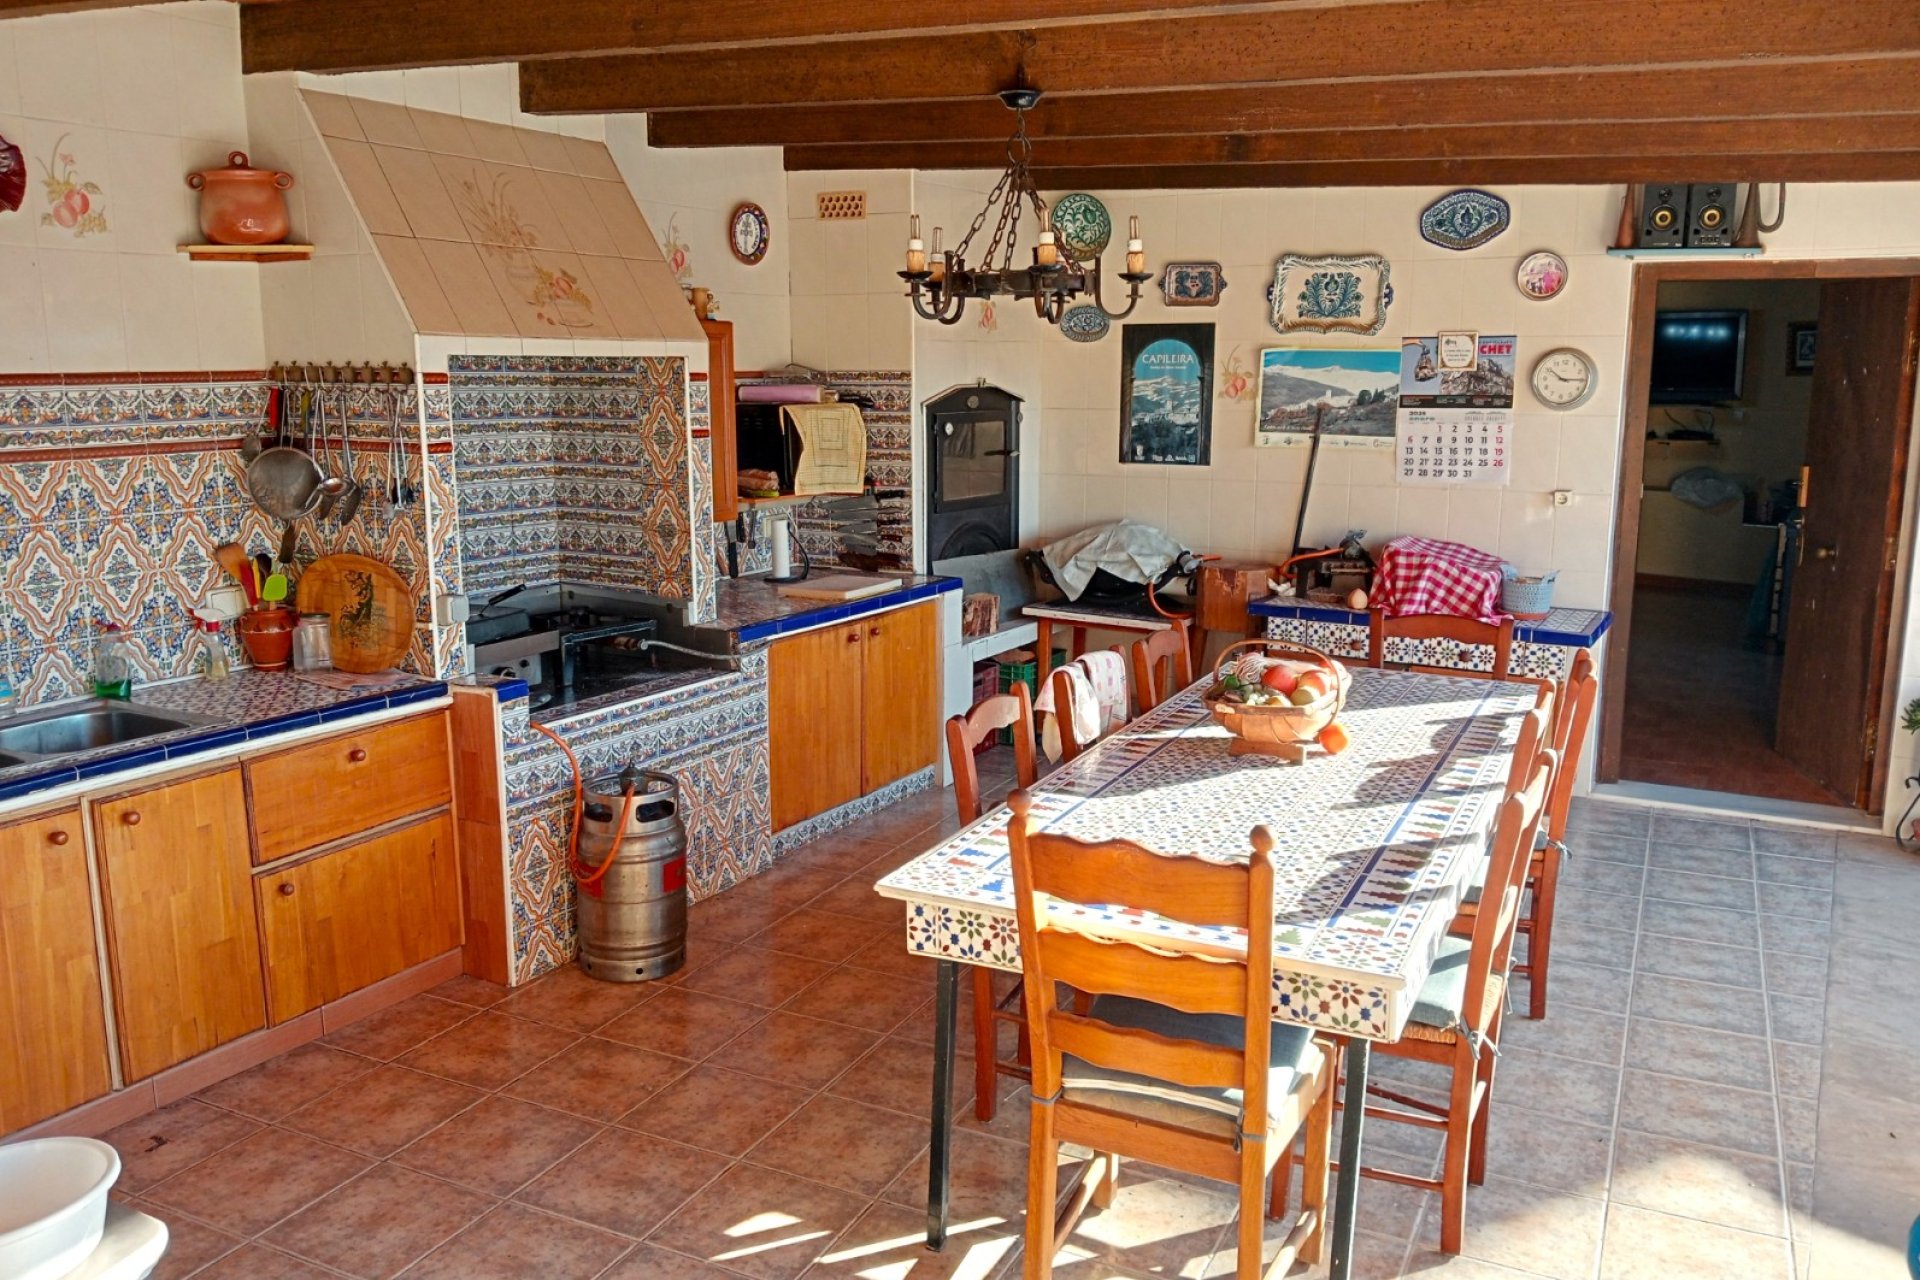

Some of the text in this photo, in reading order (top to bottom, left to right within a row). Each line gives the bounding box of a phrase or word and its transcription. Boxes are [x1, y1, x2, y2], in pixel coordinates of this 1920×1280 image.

[1478, 344, 1513, 355] CHET
[1142, 354, 1194, 364] CAPILEIRA
[1406, 447, 1413, 455] 13
